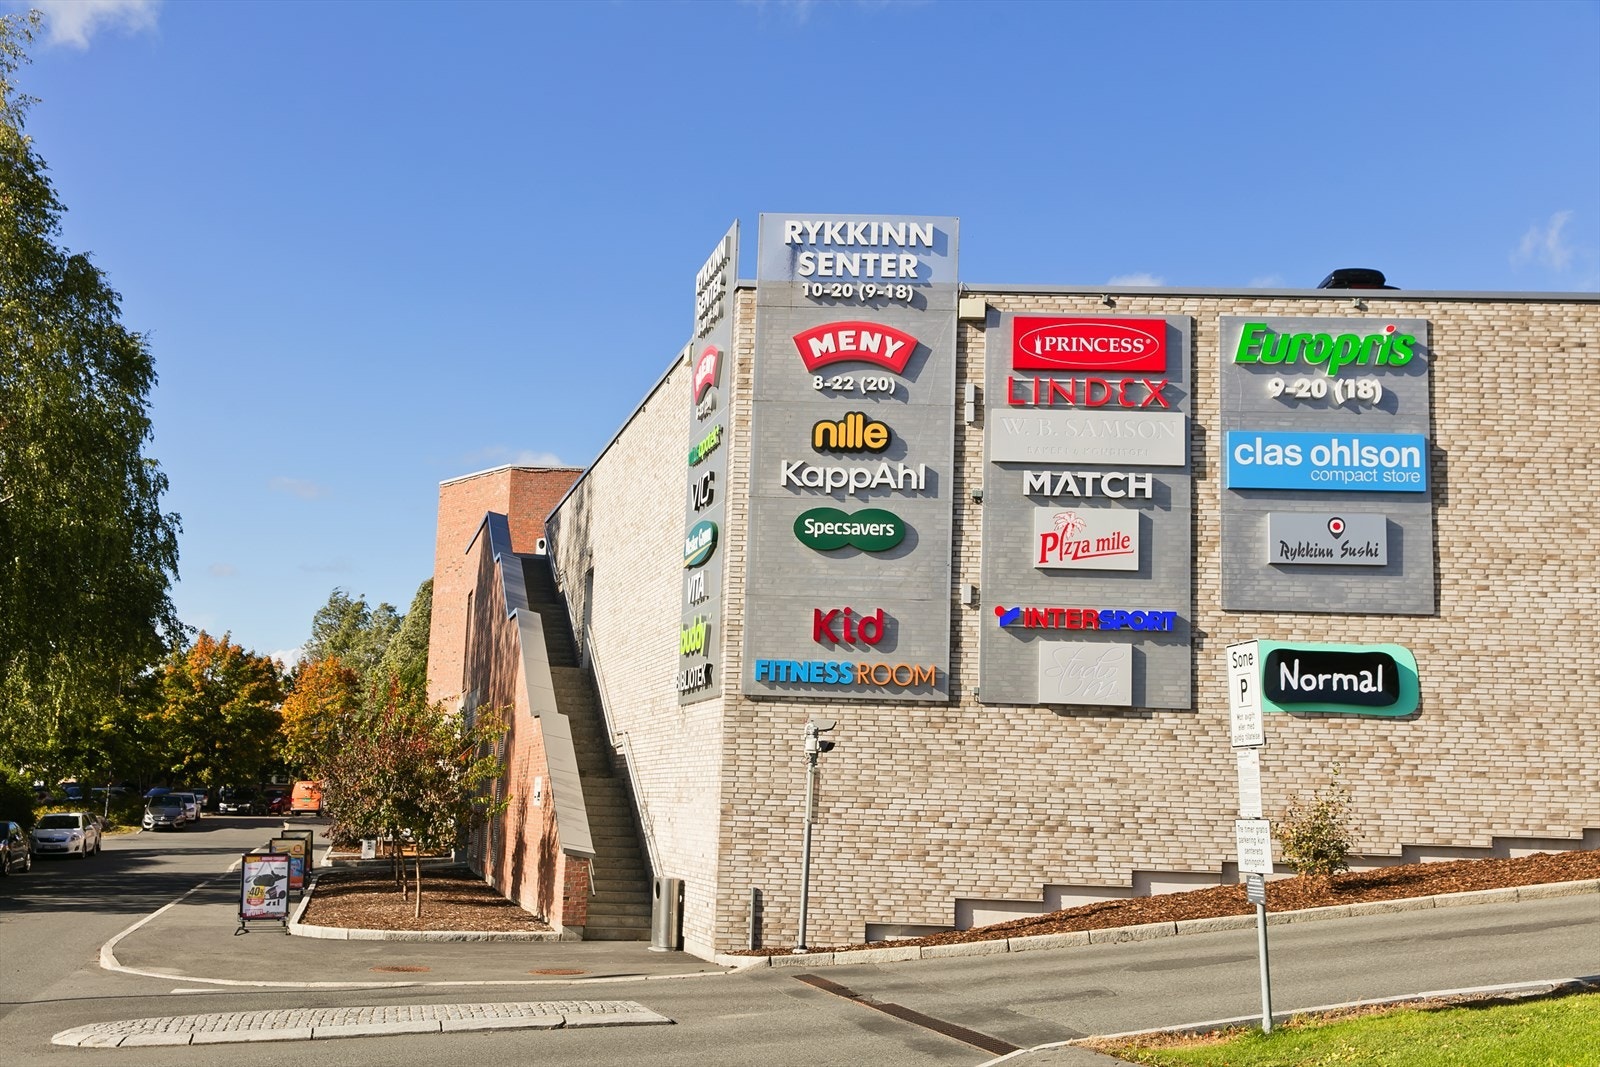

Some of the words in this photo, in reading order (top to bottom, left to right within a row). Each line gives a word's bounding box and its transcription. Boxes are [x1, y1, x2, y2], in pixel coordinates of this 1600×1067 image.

[784, 220, 934, 247] RYKKINN
[797, 252, 918, 278] SENTER
[802, 283, 853, 298] 10-20
[859, 284, 913, 302] (9-18)
[807, 330, 905, 359] MENY
[1044, 336, 1145, 354] PRINCESS
[1233, 322, 1416, 377] Europris
[812, 375, 854, 391] 8-22
[860, 377, 896, 394] (20)
[1007, 376, 1170, 409] LINDEX
[1267, 377, 1328, 400] 9-20
[1334, 378, 1383, 405] (18)
[814, 413, 889, 449] nille
[1001, 417, 1030, 436] W.
[1038, 419, 1058, 437] B.
[1066, 419, 1177, 440] SAMSON
[1234, 437, 1303, 466] clas
[1310, 438, 1421, 468] ohlson
[780, 459, 926, 495] KappAhl
[1023, 470, 1153, 499] MATCH
[1310, 468, 1378, 484] compact
[1383, 469, 1421, 483] store
[804, 518, 895, 538] Specsavers
[1096, 531, 1131, 552] mile
[1279, 540, 1334, 561] Rykkinn
[1340, 540, 1379, 559] Sushi
[688, 571, 705, 604] VITA
[812, 606, 884, 645] Kid
[1024, 607, 1177, 631] INTERSPORT
[680, 612, 707, 656] buddy
[1232, 651, 1254, 669] Sone
[1280, 659, 1383, 693] Normal
[1240, 678, 1248, 703] P
